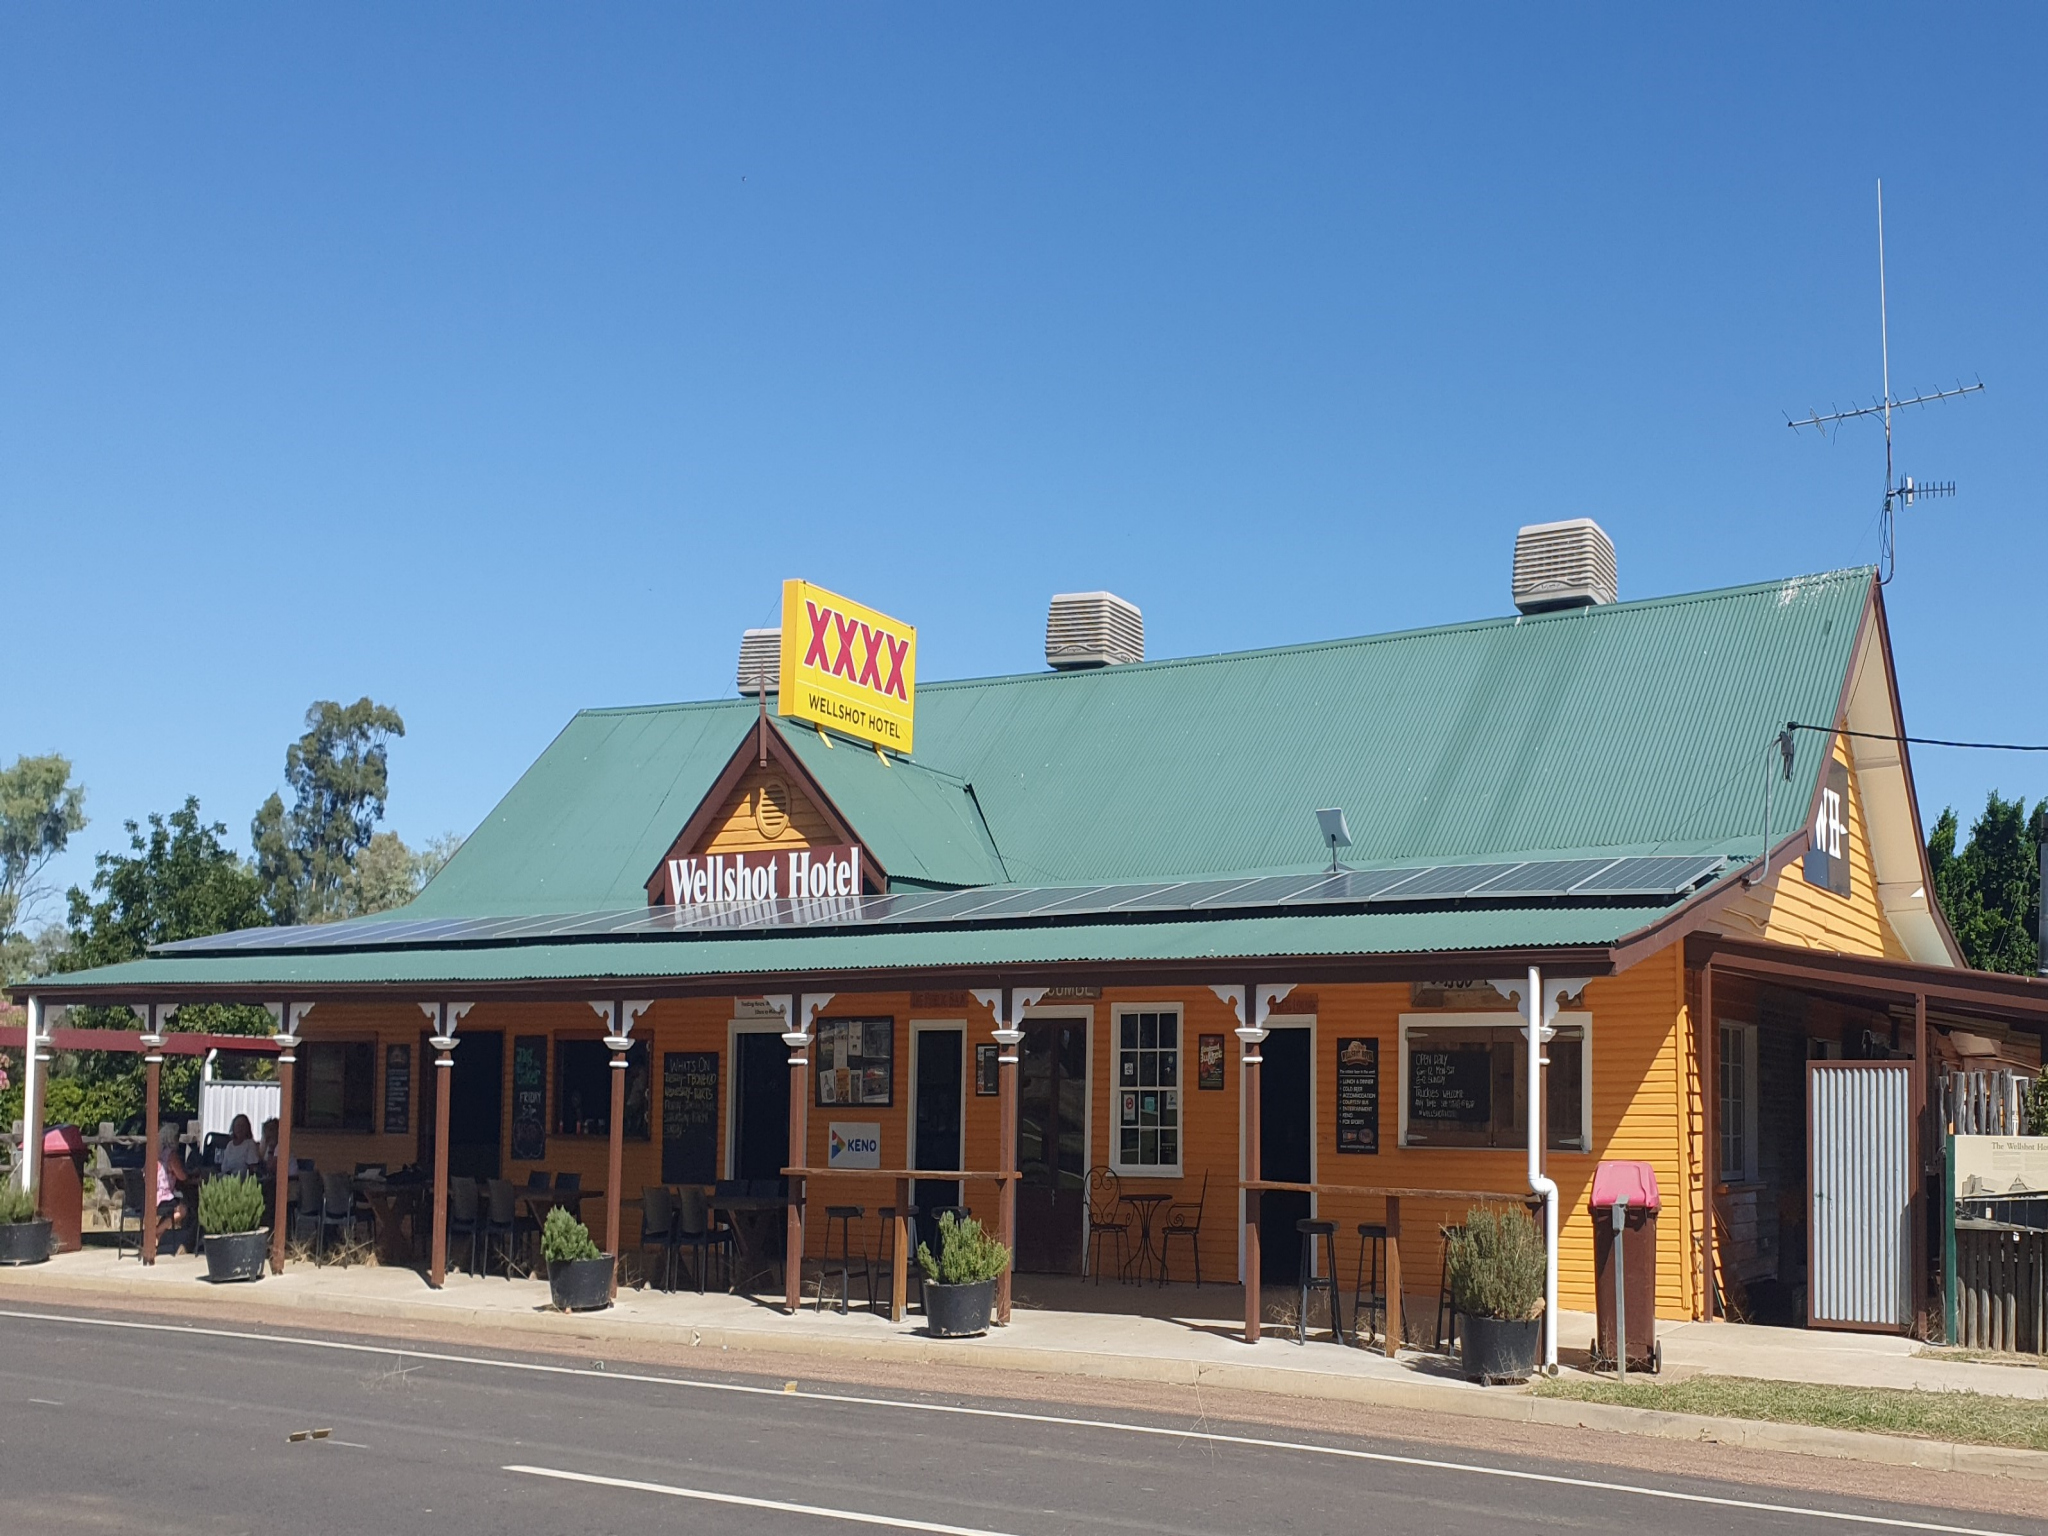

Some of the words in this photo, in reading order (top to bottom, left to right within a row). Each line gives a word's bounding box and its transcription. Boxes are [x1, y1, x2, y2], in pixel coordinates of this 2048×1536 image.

[804, 600, 910, 702] XXXX
[808, 693, 866, 727] WELLSHOT
[868, 714, 901, 739] HOTEL
[668, 854, 778, 905] Wellshot
[788, 847, 859, 898] Hotel
[847, 1138, 877, 1152] KENO
[1991, 1141, 2004, 1150] The
[2006, 1142, 2035, 1151] Wellshot
